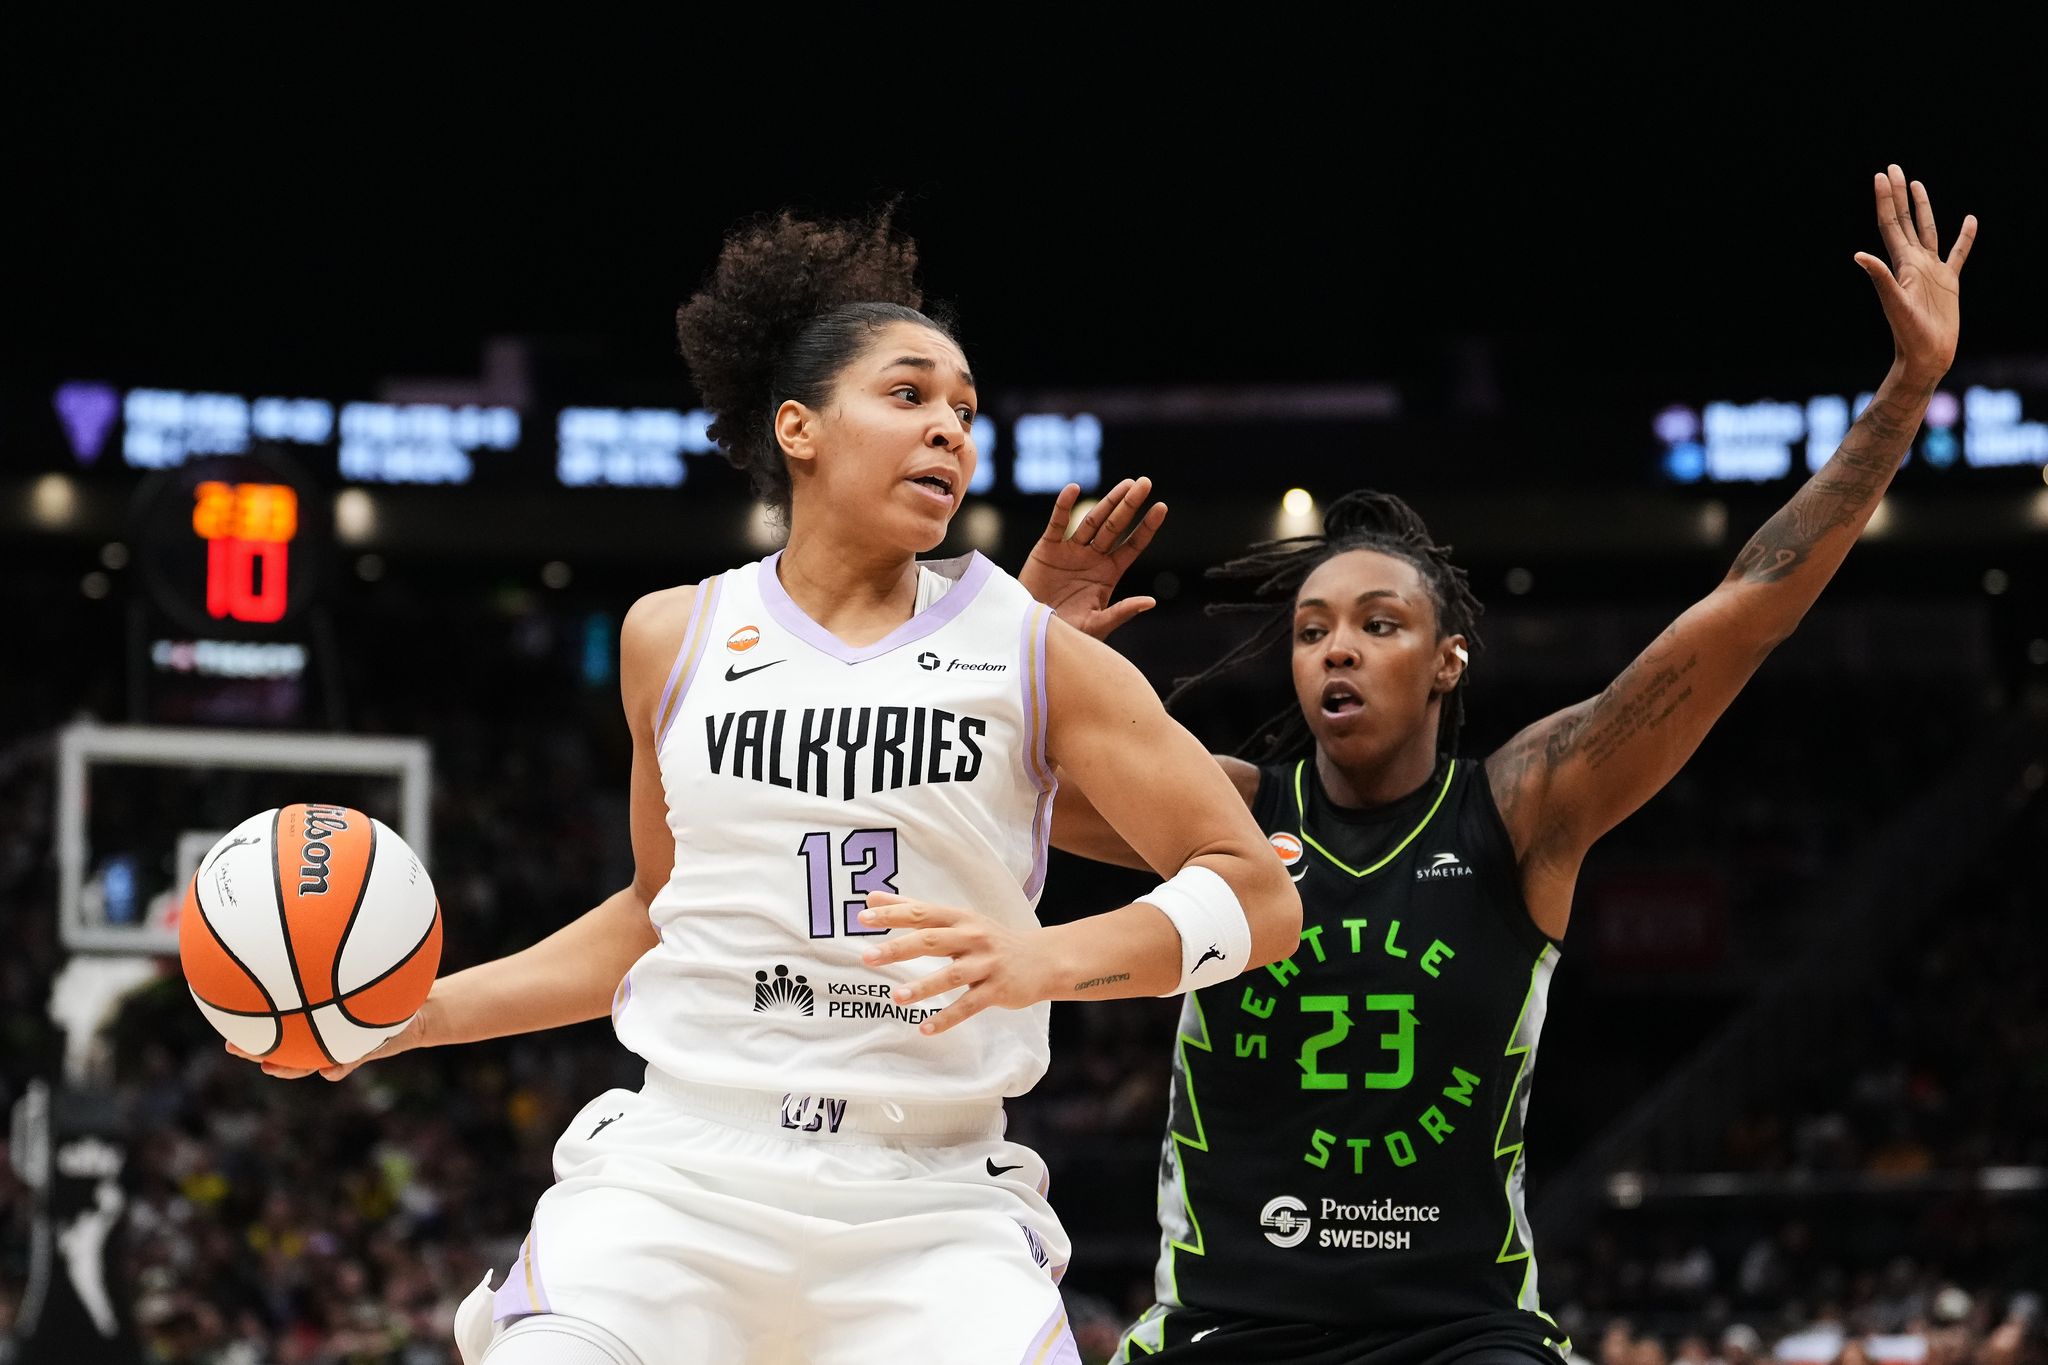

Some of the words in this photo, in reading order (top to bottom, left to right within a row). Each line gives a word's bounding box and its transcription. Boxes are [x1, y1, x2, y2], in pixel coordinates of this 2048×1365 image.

[206, 538, 288, 622] 10
[946, 659, 1007, 672] freedom
[705, 706, 987, 801] VALKYRIES
[797, 828, 899, 939] 13
[1416, 866, 1473, 879] SYMETRA
[828, 983, 891, 999] KAISER
[1235, 918, 1455, 1062] SEATTLE
[1295, 994, 1420, 1090] 23
[1304, 1065, 1481, 1174] STORM
[1318, 1228, 1411, 1250] SWEDISH
[1319, 1197, 1441, 1222] Providence
